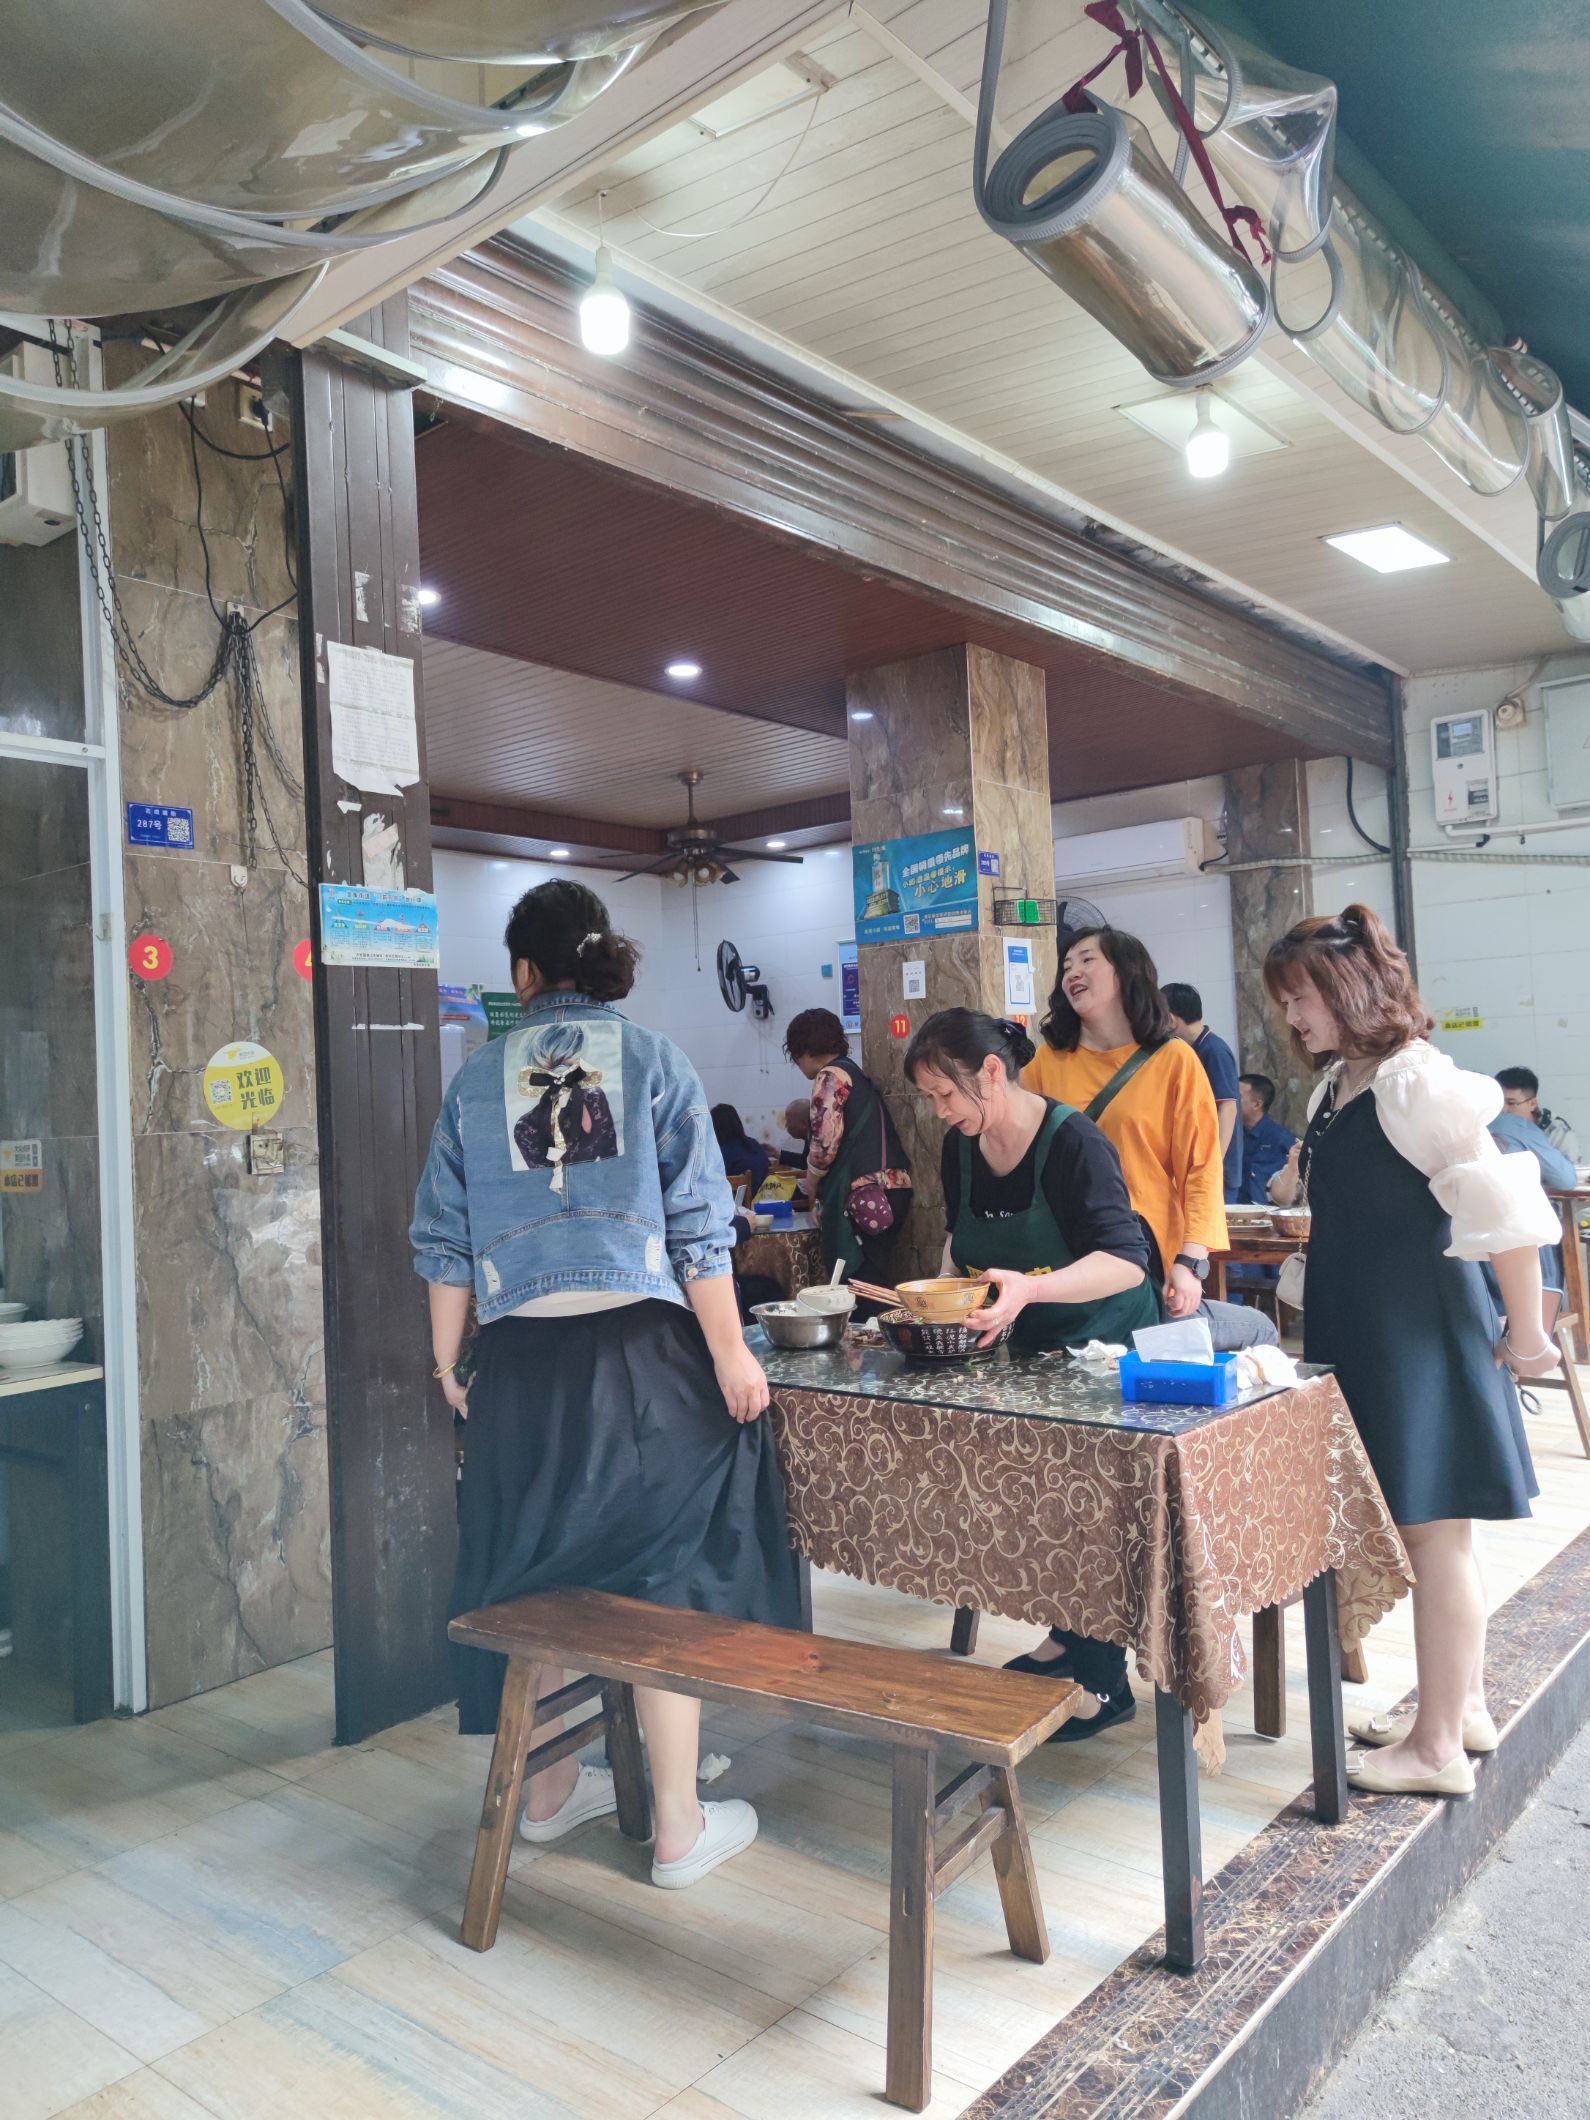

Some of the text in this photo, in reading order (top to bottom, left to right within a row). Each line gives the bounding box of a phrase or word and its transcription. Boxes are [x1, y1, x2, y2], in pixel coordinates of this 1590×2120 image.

[136, 819, 162, 830] 287号
[914, 868, 967, 897] 小心地滑
[142, 945, 159, 969] 3
[895, 1019, 906, 1033] 11
[235, 1067, 272, 1090] 欢迎
[241, 1088, 275, 1110] 光临
